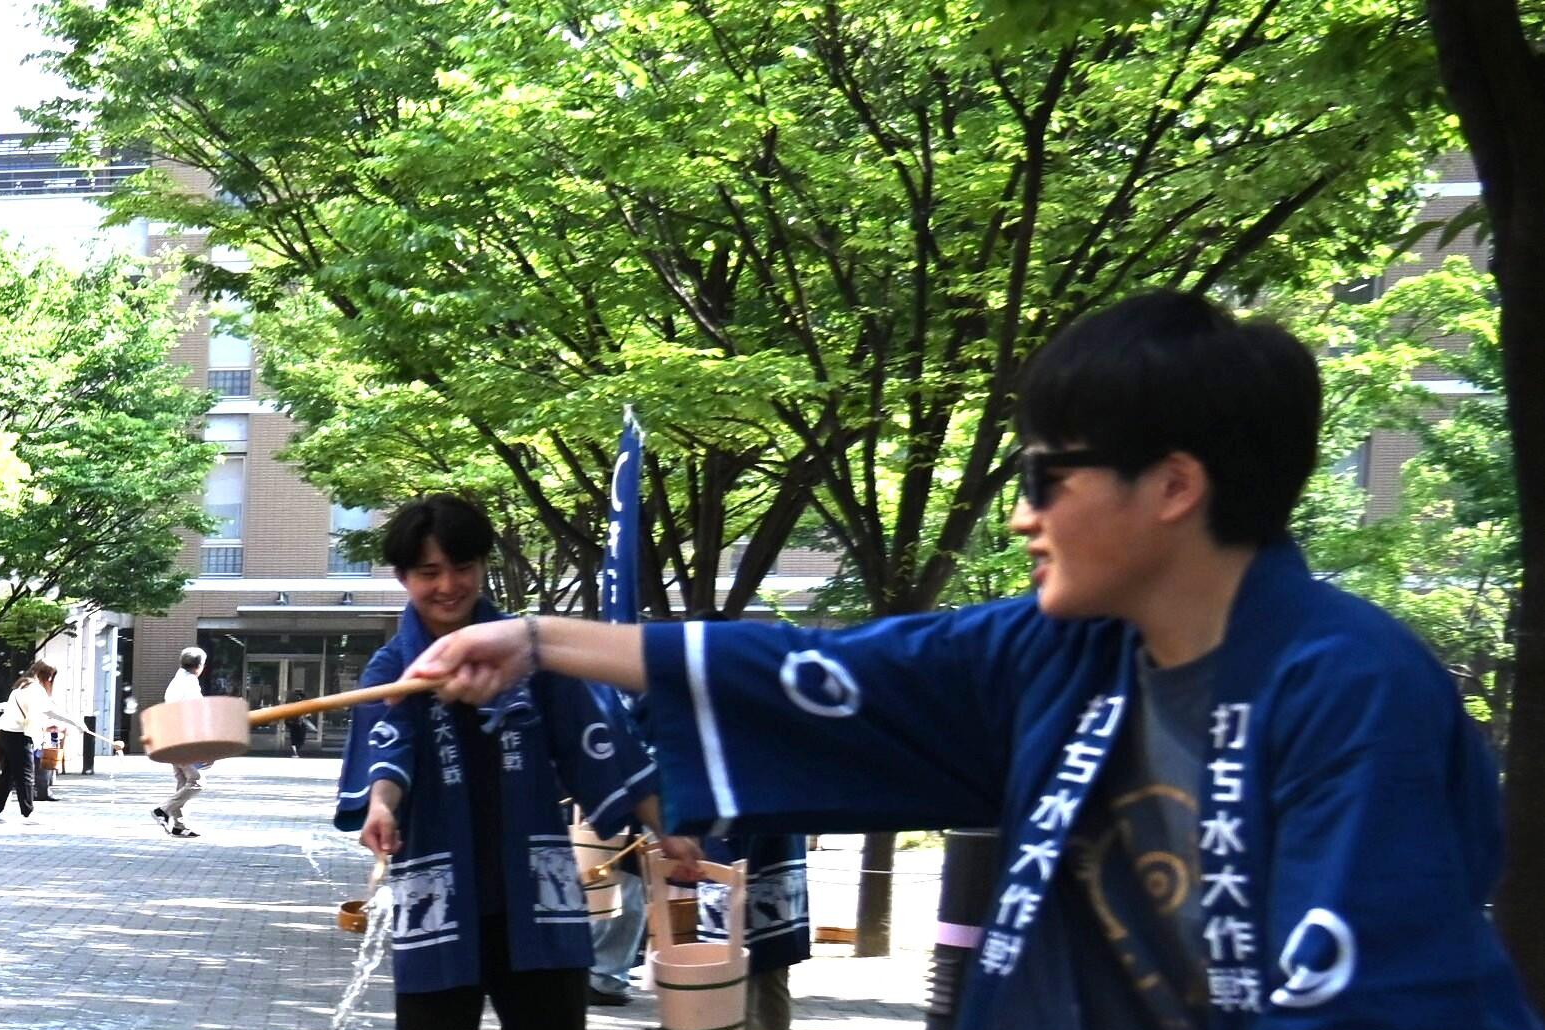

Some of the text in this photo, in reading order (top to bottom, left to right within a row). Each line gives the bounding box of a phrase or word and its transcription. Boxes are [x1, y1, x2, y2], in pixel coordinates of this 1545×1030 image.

[429, 696, 462, 785] 水大作戦
[980, 694, 1126, 977] 打ち水大作戦
[1199, 702, 1262, 1013] 打ち水大作戦
